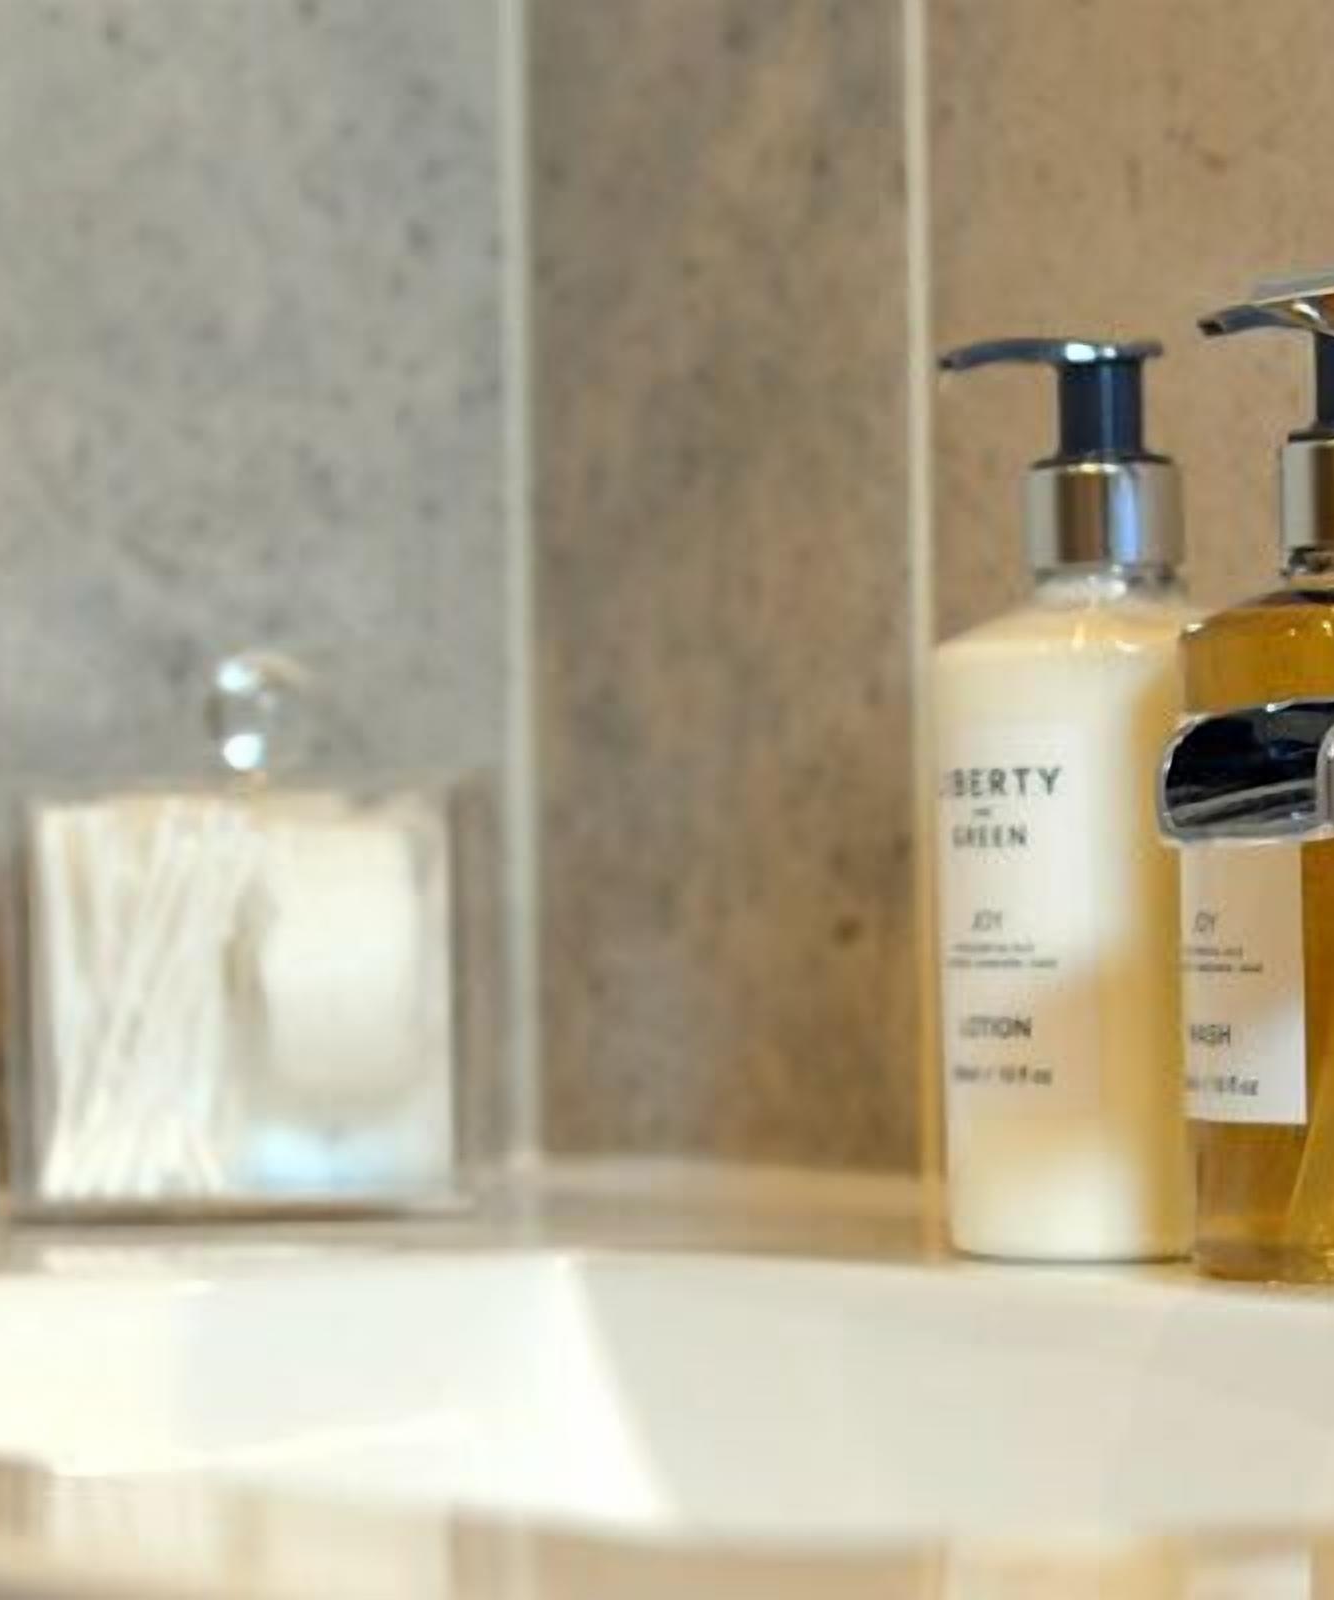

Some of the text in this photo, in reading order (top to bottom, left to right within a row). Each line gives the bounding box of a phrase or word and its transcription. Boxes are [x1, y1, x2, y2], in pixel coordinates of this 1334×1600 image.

[938, 767, 1061, 797] IBERTY
[951, 824, 1027, 848] GREEN
[957, 1015, 1032, 1039] LOTION
